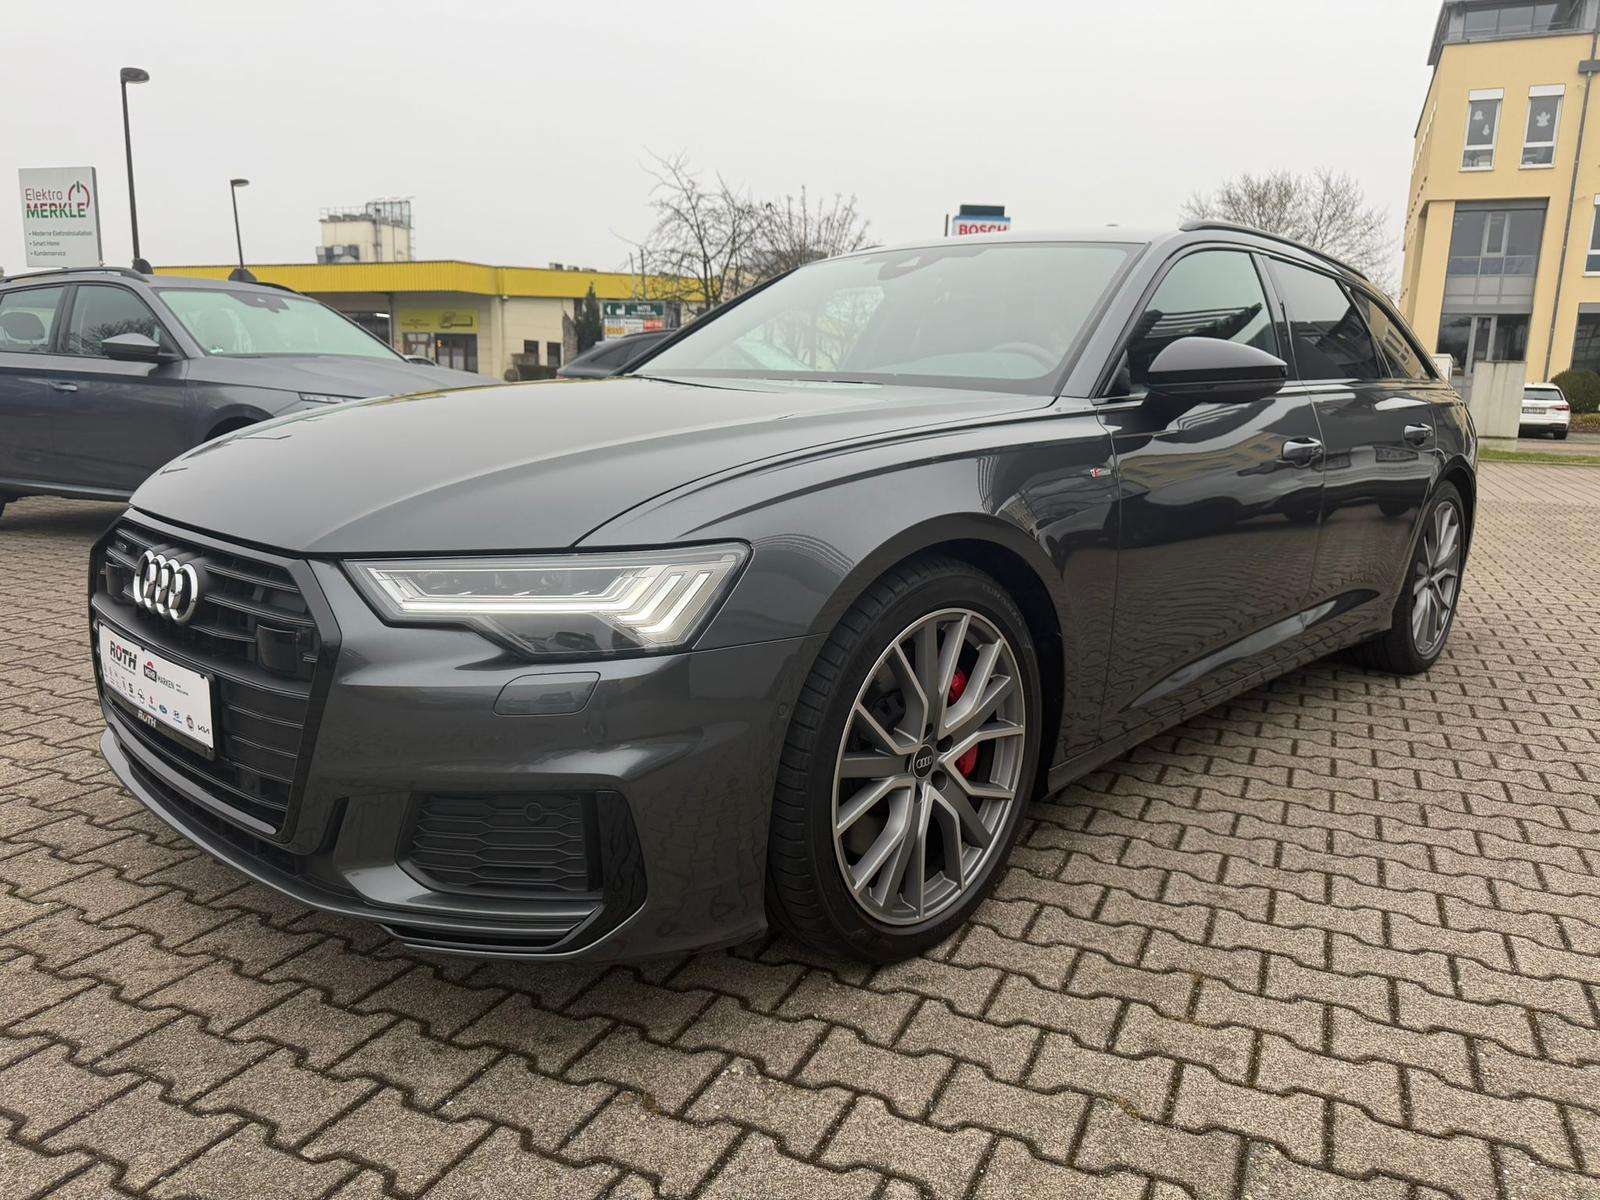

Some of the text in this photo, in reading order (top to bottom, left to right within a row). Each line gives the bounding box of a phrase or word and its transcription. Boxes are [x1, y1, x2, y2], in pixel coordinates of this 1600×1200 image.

[25, 188, 63, 201] Elektro
[26, 202, 86, 218] MERKLE
[959, 224, 1007, 235] BOSCH
[109, 640, 138, 671] ROTH
